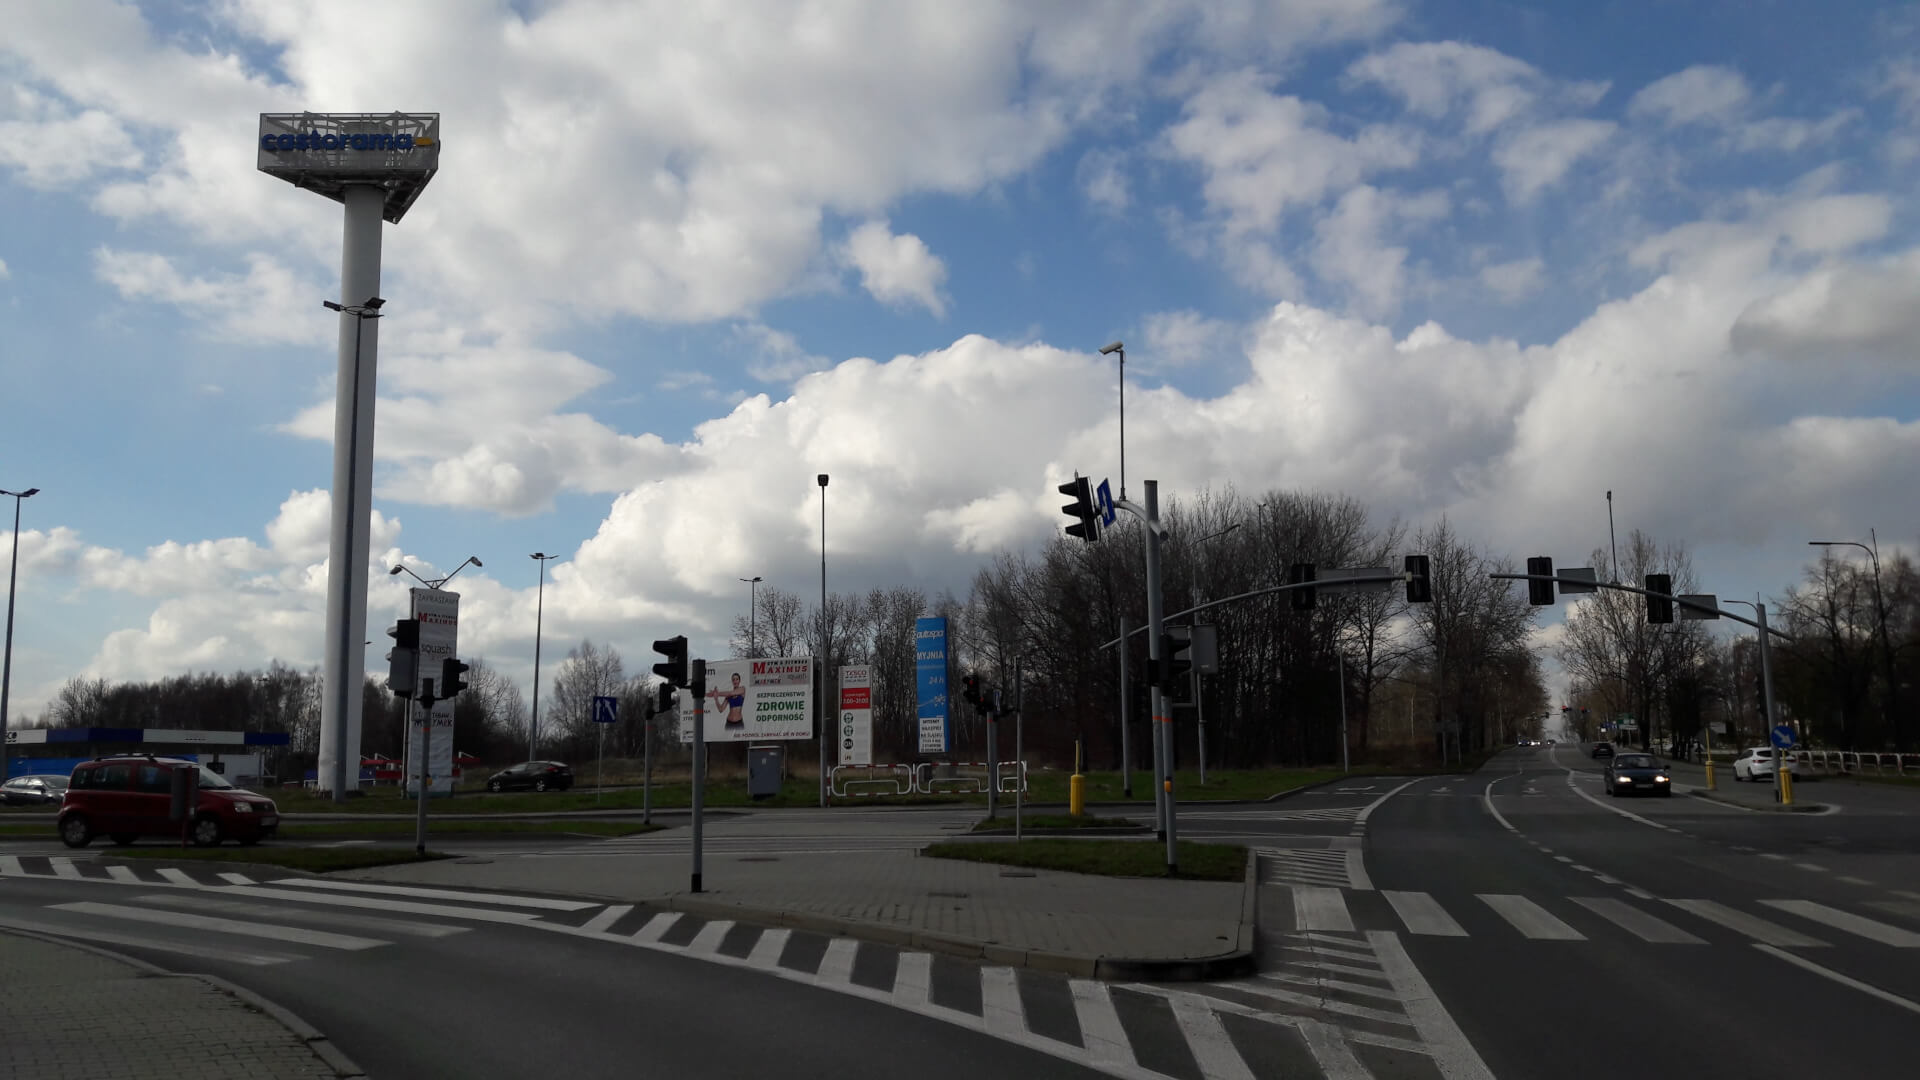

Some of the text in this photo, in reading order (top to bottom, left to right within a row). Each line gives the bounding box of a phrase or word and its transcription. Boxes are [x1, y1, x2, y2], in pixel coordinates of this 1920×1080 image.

[261, 130, 413, 150] castorama
[916, 650, 945, 660] MYJNIA
[752, 662, 808, 675] MAXIMUS
[756, 700, 805, 712] ZDROWIE
[756, 712, 804, 722] ODPORNOŚĆ
